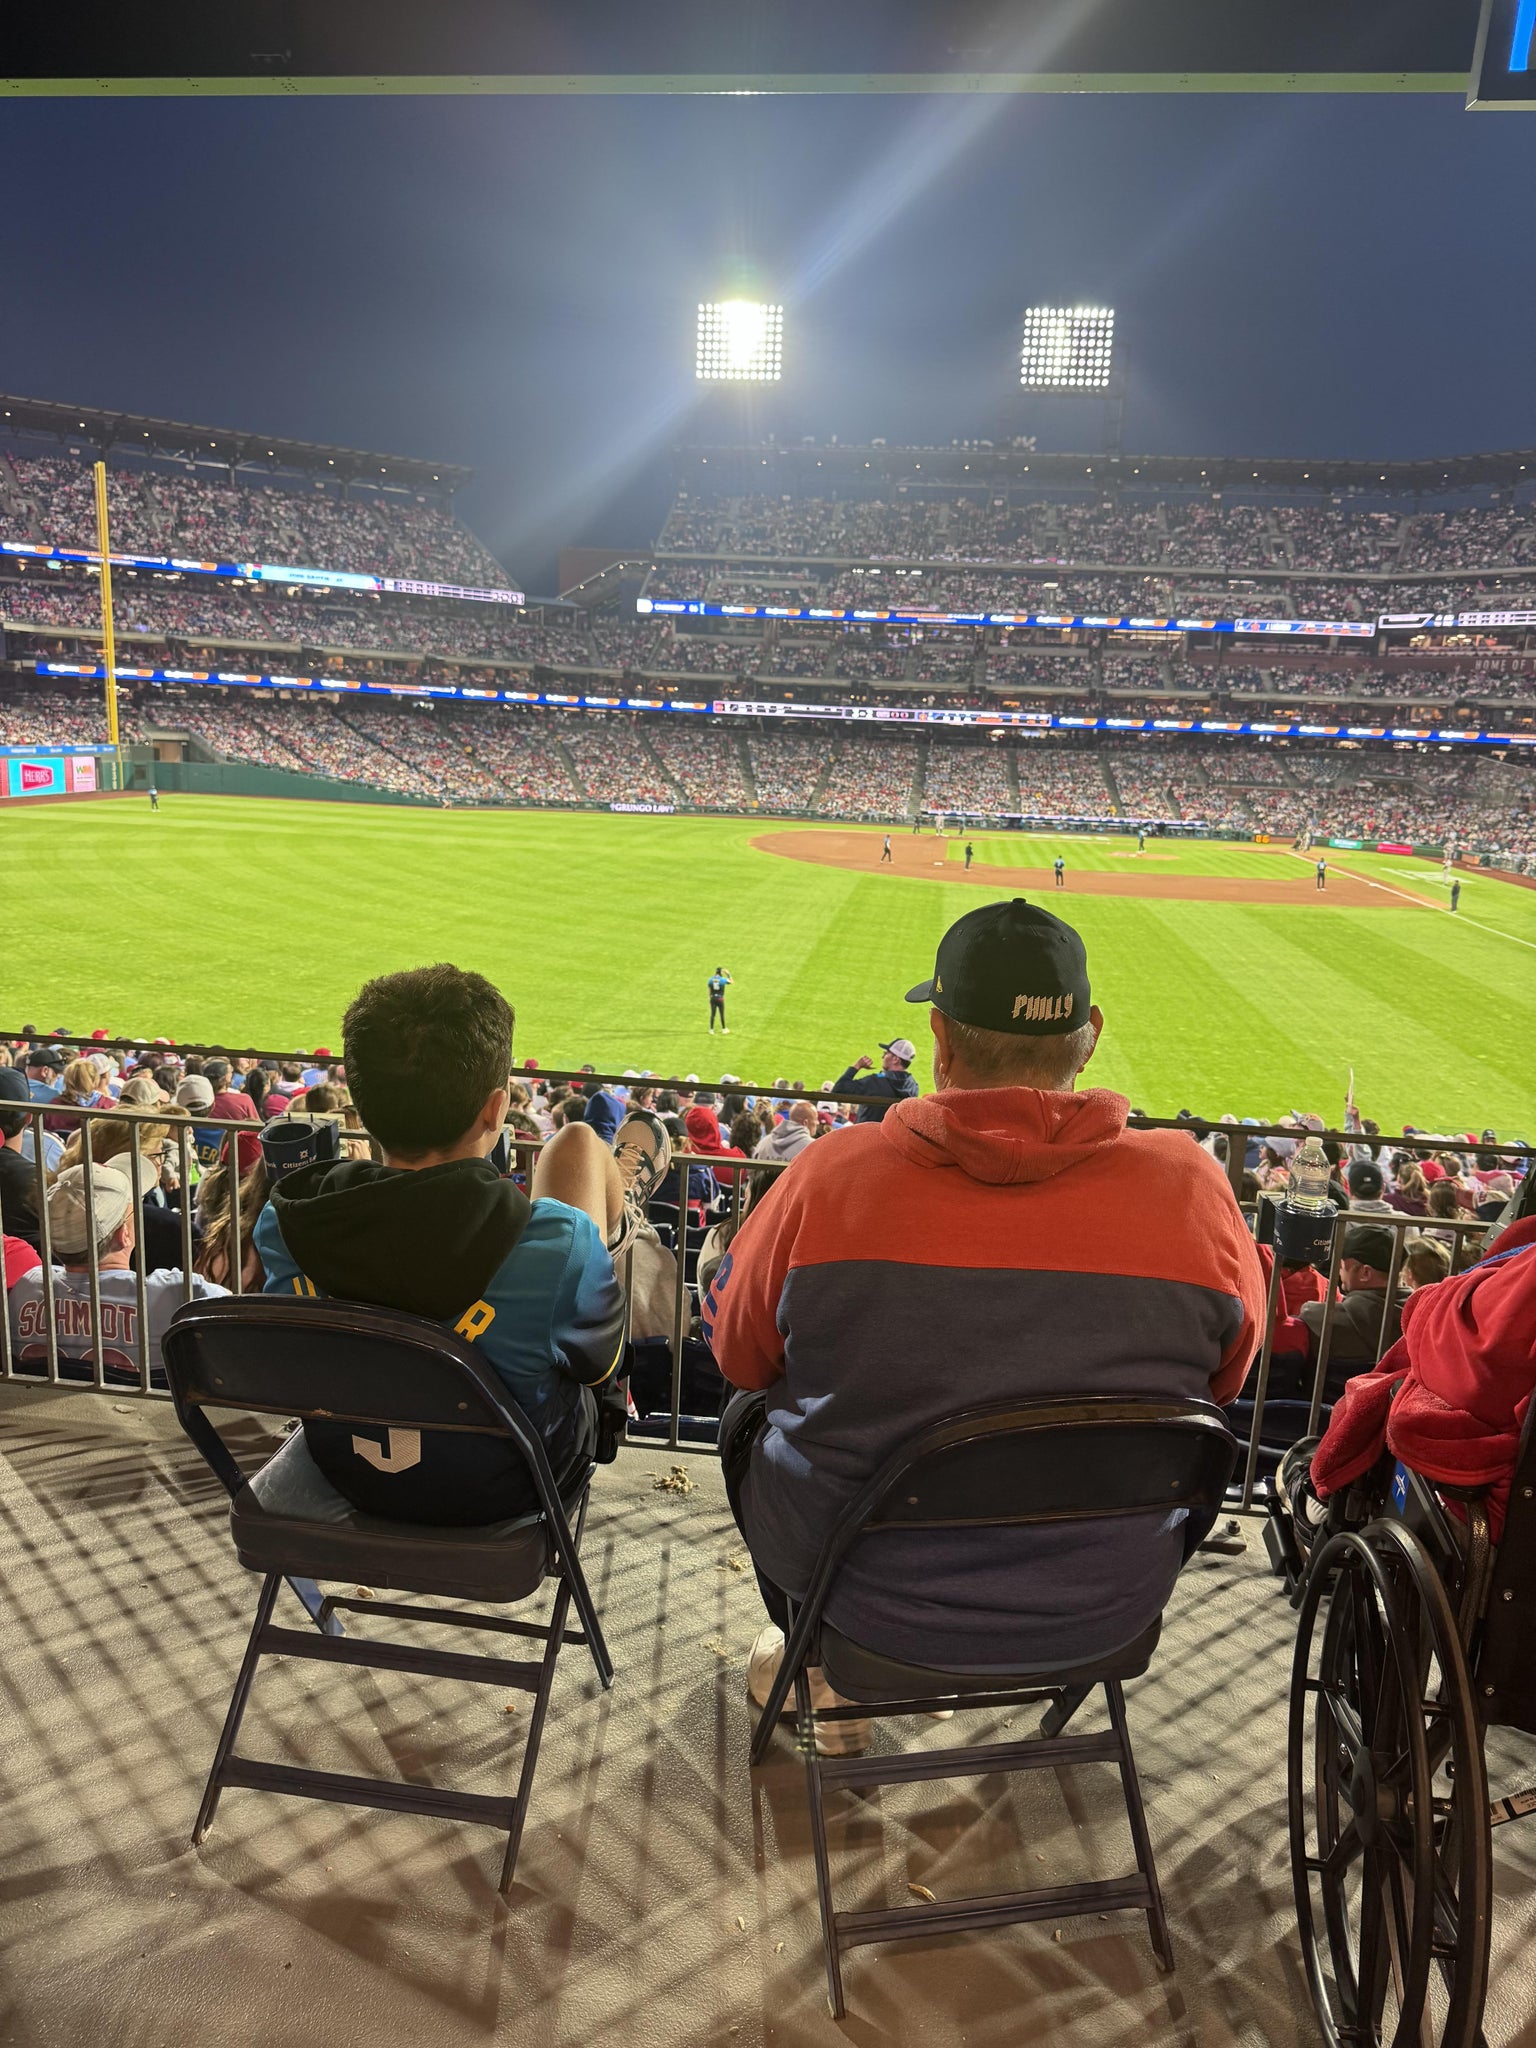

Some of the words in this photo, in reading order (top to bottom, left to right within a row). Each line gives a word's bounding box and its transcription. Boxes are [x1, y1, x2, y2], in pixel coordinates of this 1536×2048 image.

[1475, 659, 1506, 670] HOME
[1512, 659, 1526, 671] OF
[1011, 993, 1073, 1021] PHILLY
[18, 1298, 138, 1344] SCHMDT
